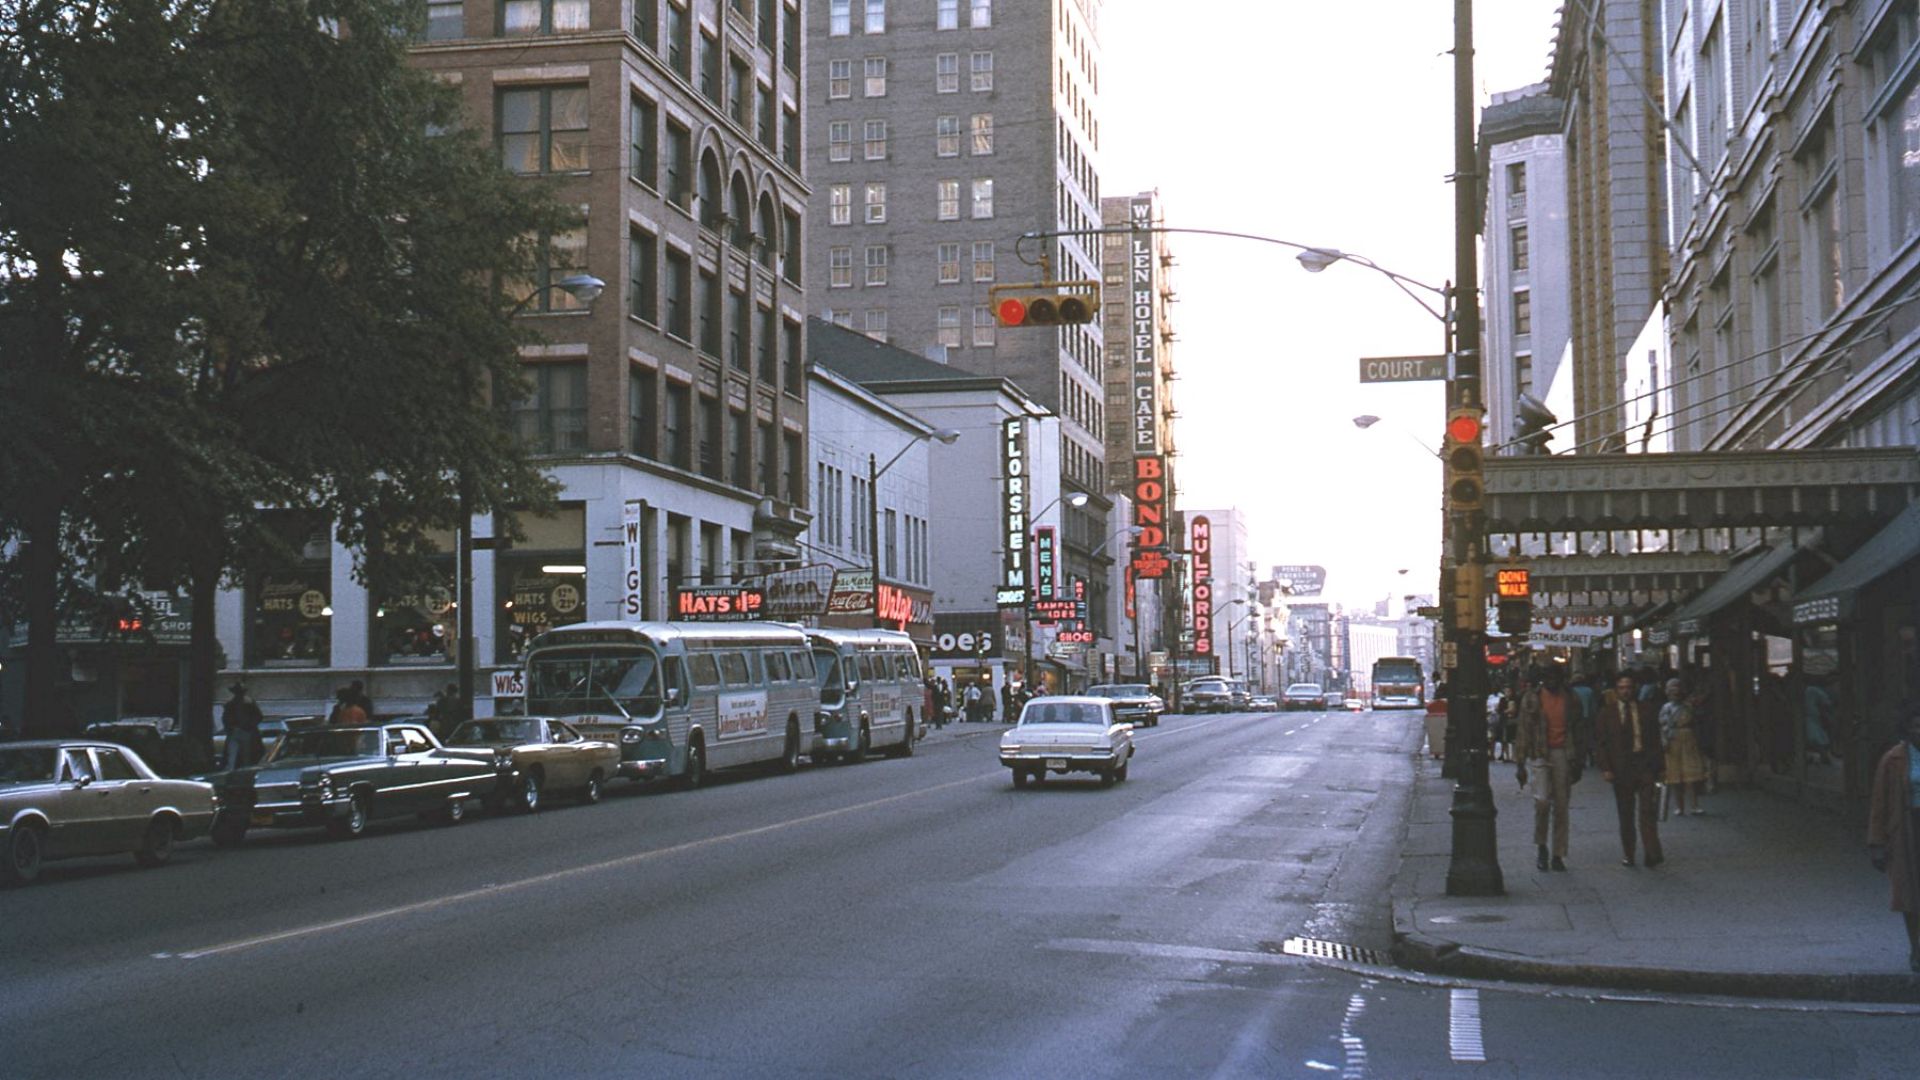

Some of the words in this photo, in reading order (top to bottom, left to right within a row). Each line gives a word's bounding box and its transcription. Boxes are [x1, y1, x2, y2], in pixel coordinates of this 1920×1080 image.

[1134, 240, 1150, 283] LEN
[1135, 291, 1150, 362] HOTEL
[1135, 370, 1152, 378] AND
[1367, 361, 1423, 379] COURT
[1137, 386, 1153, 444] CAFE
[1007, 421, 1024, 586] FLORSHEIM
[1136, 458, 1163, 547] BOND
[627, 522, 639, 615] WIGS
[1039, 537, 1053, 596] MEN'S
[1499, 571, 1527, 582] DONT
[1193, 524, 1210, 652] MULFORD'S
[1499, 584, 1528, 595] WALK
[515, 593, 545, 605] HATS
[680, 592, 730, 613] HATS
[1036, 602, 1075, 610] SAMPLE
[513, 612, 547, 624] WIGS
[932, 633, 992, 651] oes
[1560, 634, 1588, 643] BASKET
[495, 674, 524, 693] WIGS
